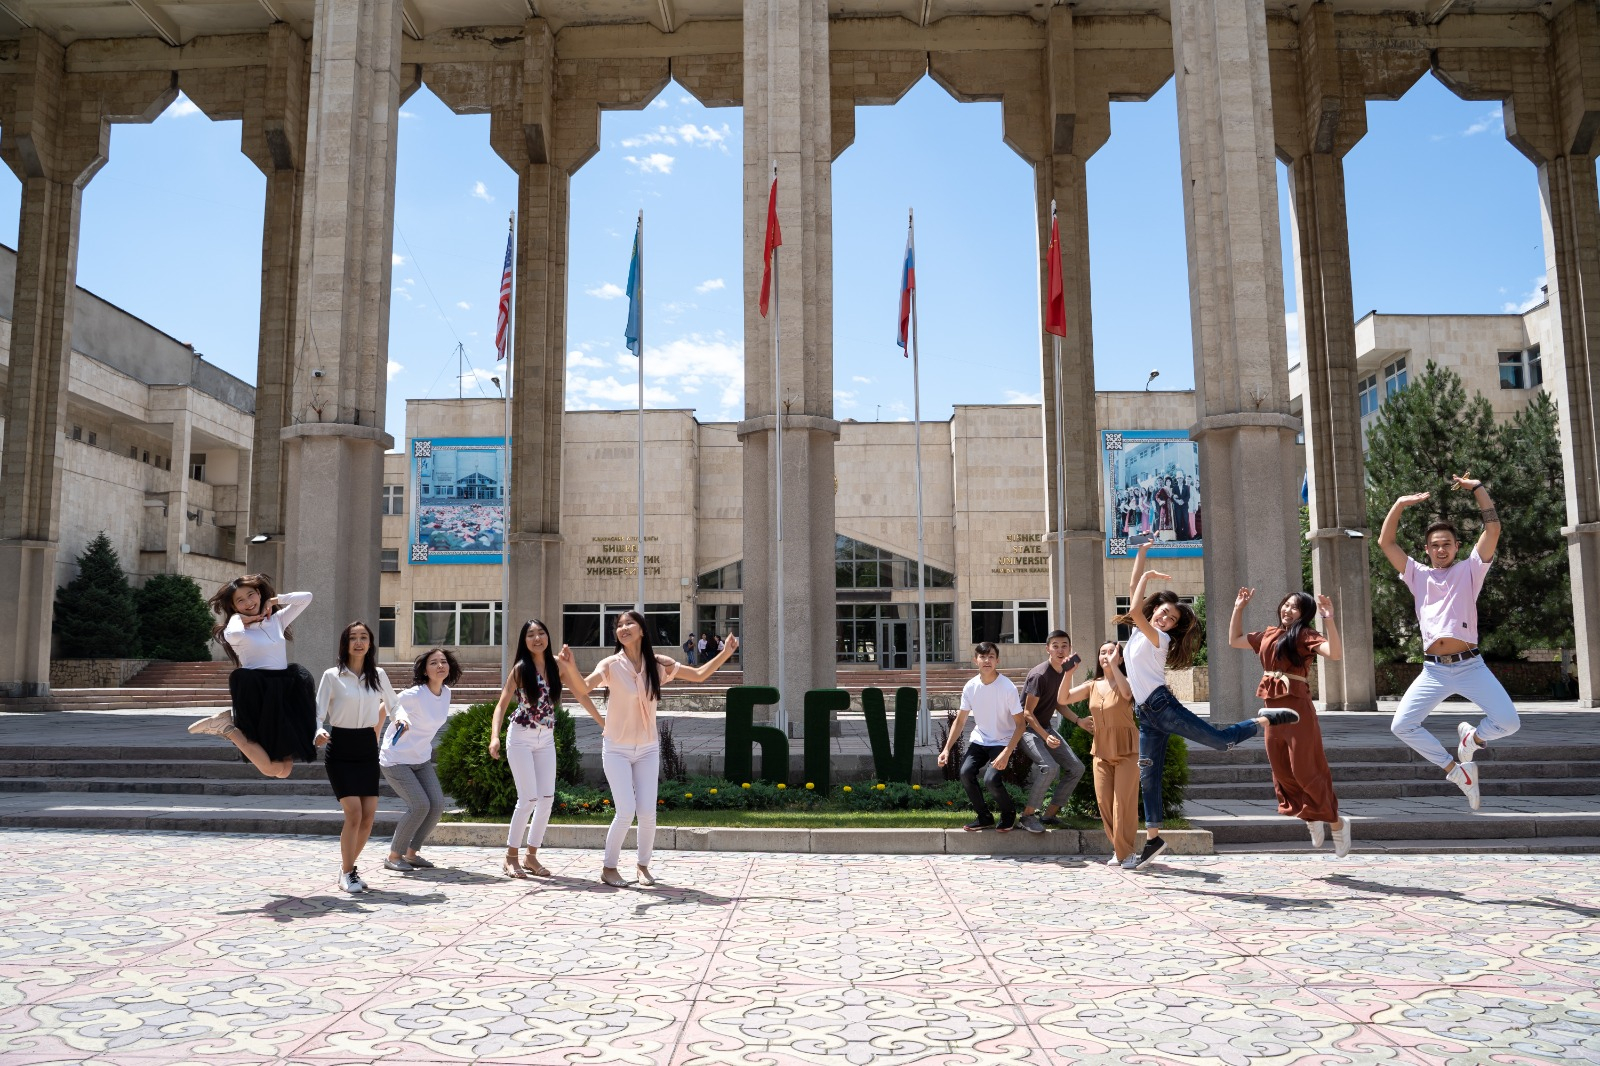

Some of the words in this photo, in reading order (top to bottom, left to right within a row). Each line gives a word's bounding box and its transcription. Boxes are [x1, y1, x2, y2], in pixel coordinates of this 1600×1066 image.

[1007, 534, 1042, 542] BISHKE
[603, 544, 639, 552] БИШКЕ
[1013, 545, 1041, 553] STATE
[587, 556, 660, 564] МАМЛЕКЕТИК
[999, 556, 1049, 565] UNIVERSIT
[587, 567, 660, 575] УНИВЕРСИЕТИ
